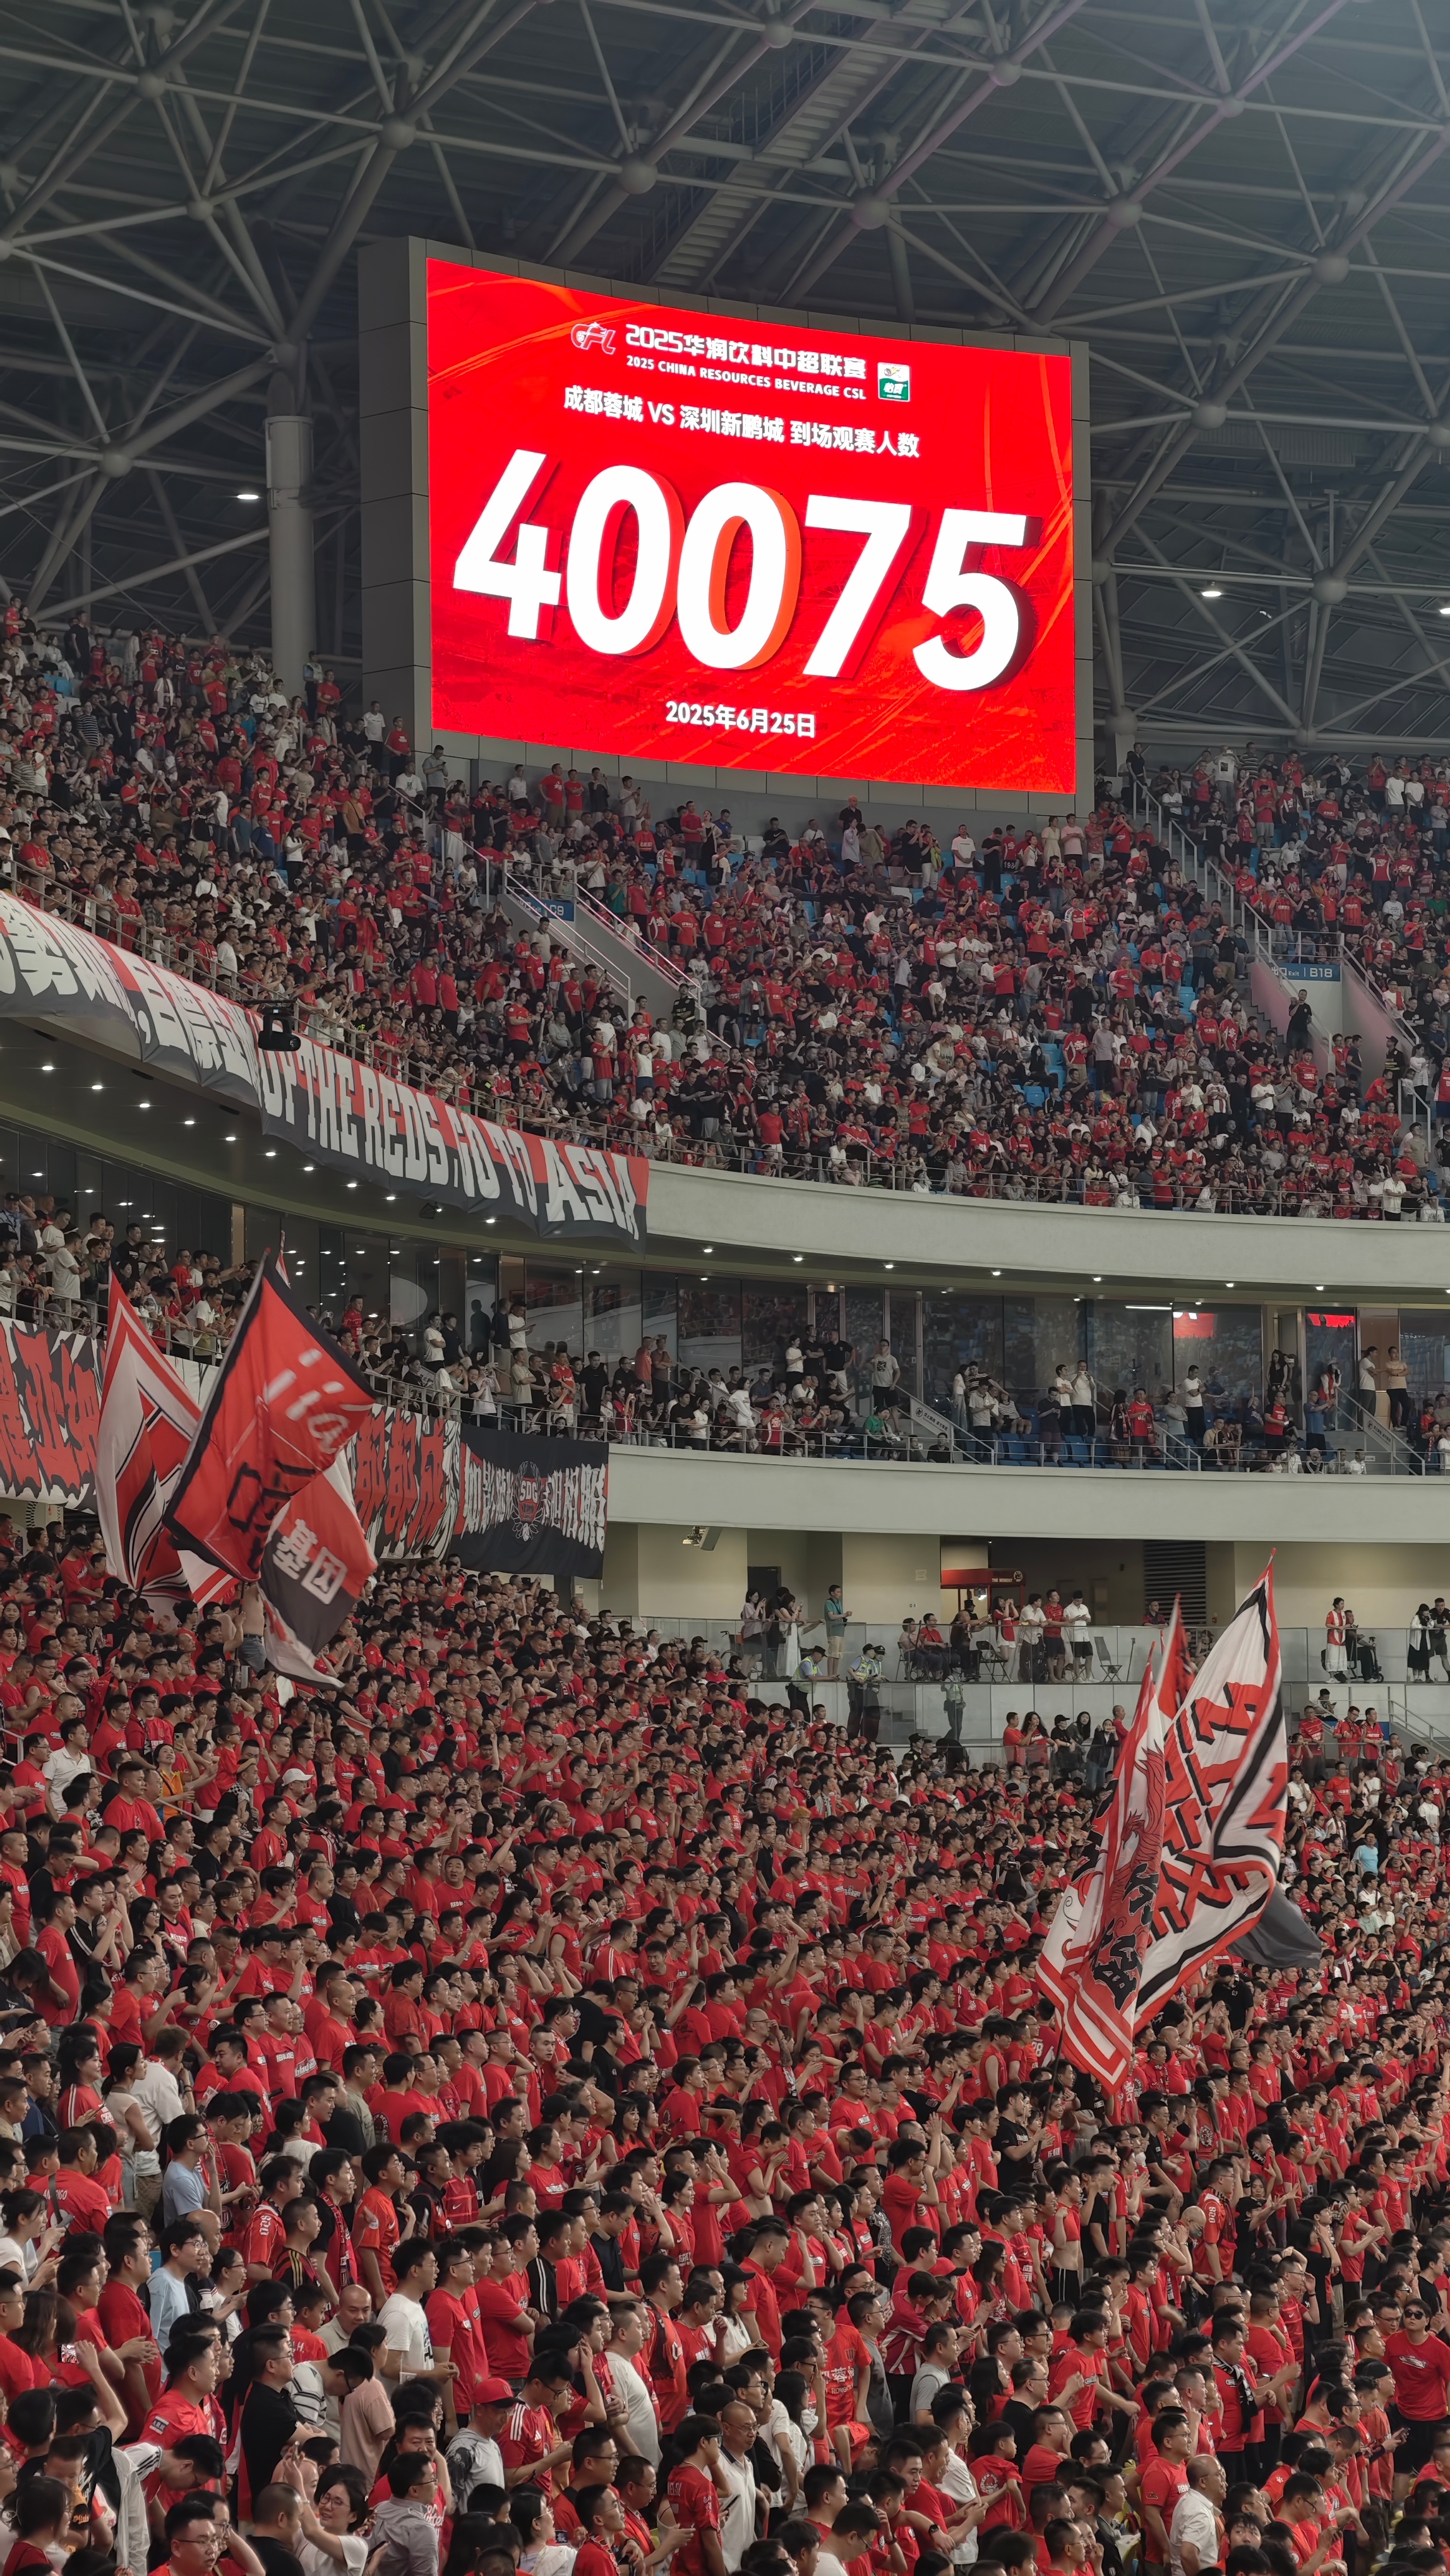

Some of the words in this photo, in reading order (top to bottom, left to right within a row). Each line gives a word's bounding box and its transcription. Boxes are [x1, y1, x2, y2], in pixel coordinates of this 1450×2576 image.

[625, 324, 866, 379] 2025华润饮料中超联赛
[626, 355, 654, 370] 2025
[658, 361, 696, 376] CHINA
[700, 367, 771, 388] RESOURCES
[774, 378, 840, 397] BEVERAGE
[843, 386, 866, 400] CSL
[563, 385, 644, 422] 成都蓉城
[647, 401, 675, 426] VS
[680, 404, 785, 443] 深圳新鹏城
[789, 420, 920, 458] 到场观赛人数
[452, 449, 1028, 691] 40075
[666, 701, 815, 737] 2025年6月25日
[549, 904, 564, 916] C9
[1309, 967, 1333, 978] B18
[292, 1032, 359, 1159] THE
[360, 1064, 448, 1186] REDS
[445, 1105, 501, 1199] GO
[480, 1119, 538, 1217] TO
[539, 1138, 640, 1241] ASIA
[520, 1481, 538, 1503] SDG
[272, 1518, 349, 1605] 基因
